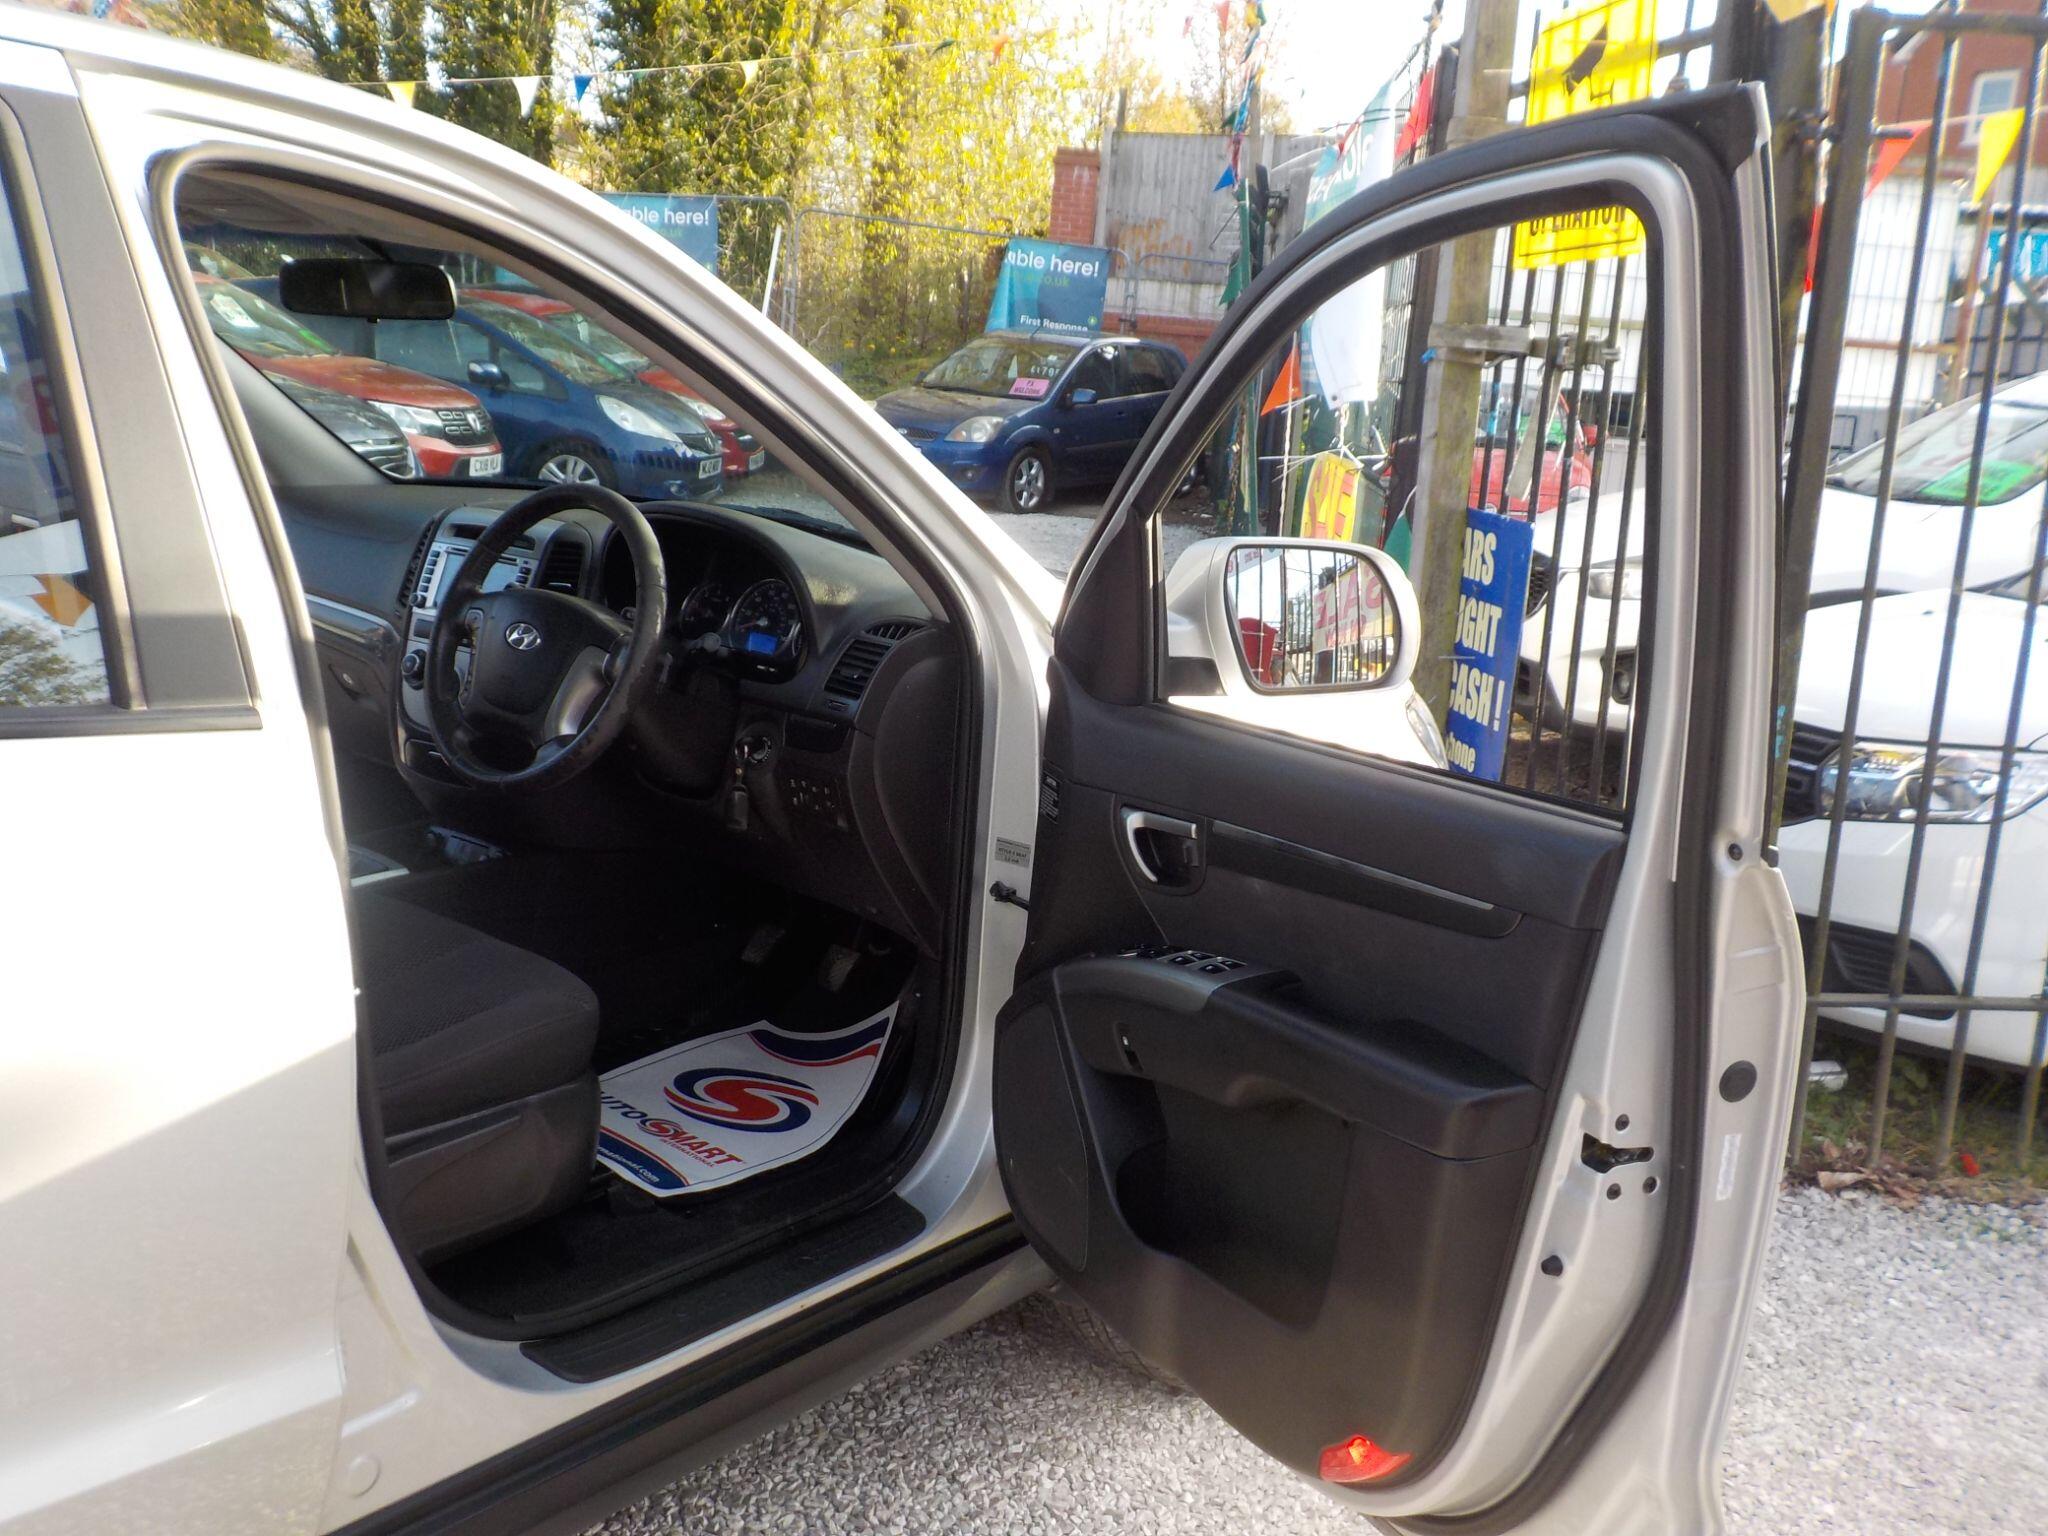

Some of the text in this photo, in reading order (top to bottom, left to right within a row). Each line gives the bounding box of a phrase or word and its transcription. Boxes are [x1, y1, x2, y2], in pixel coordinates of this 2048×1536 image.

[664, 207, 709, 225] here!
[1050, 254, 1099, 277] here!
[1020, 315, 1041, 327] First
[1462, 527, 1497, 586] ARS
[1446, 731, 1476, 773] hone
[600, 1091, 744, 1165] UTOSMART
